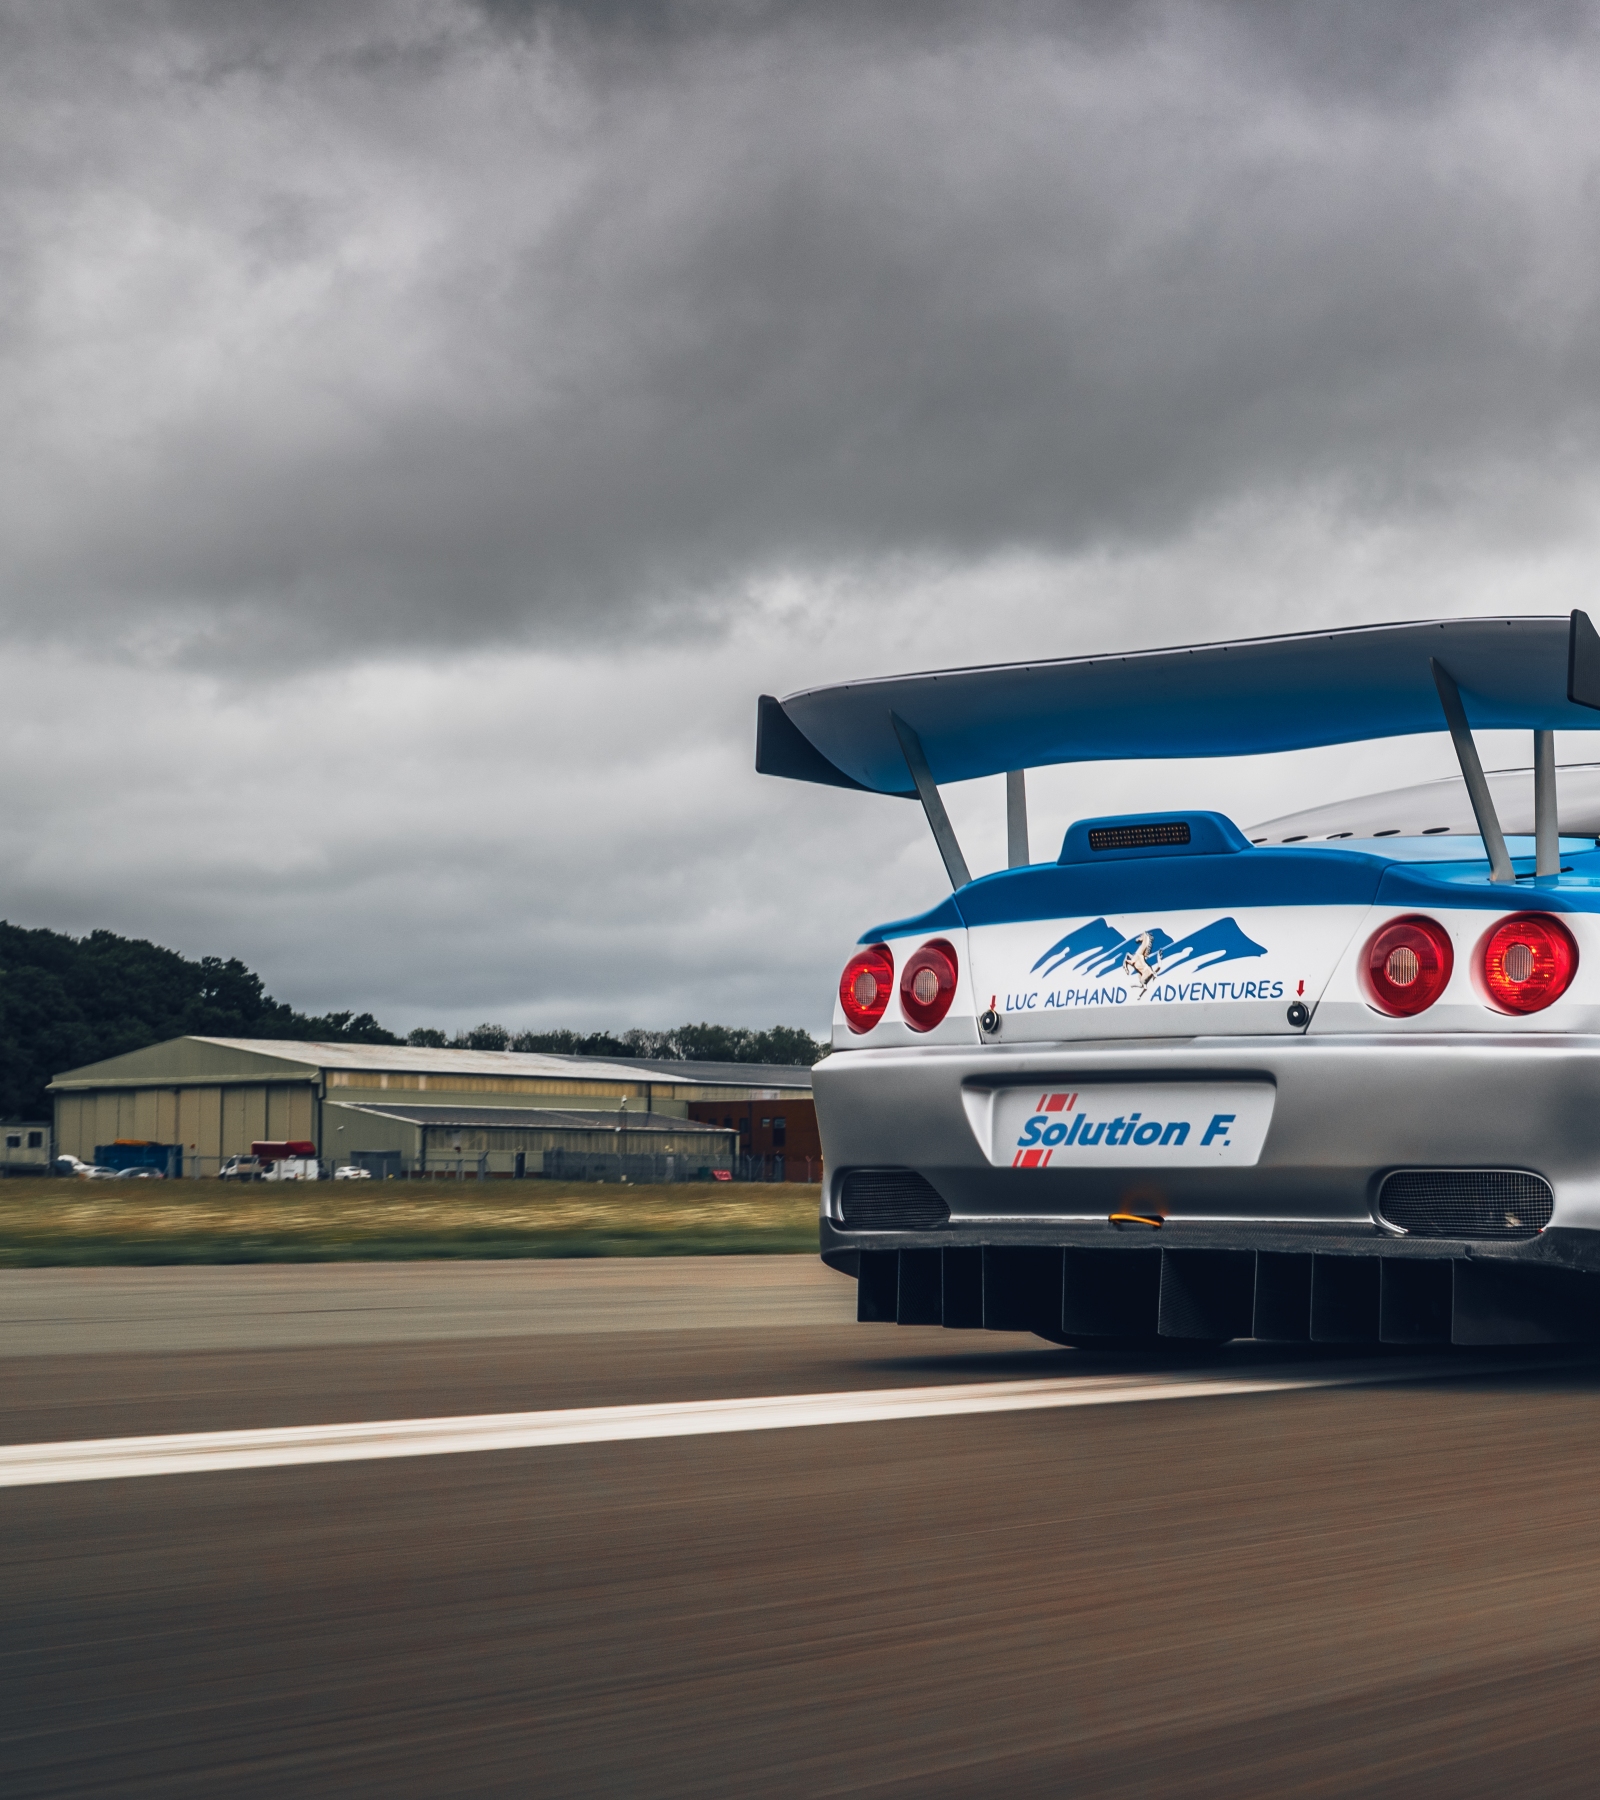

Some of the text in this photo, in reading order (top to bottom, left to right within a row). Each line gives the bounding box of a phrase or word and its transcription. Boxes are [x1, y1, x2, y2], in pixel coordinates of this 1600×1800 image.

[1005, 980, 1284, 1011] LUC ALPHAND ADVENTURES
[1017, 1113, 1236, 1147] Solution F.
